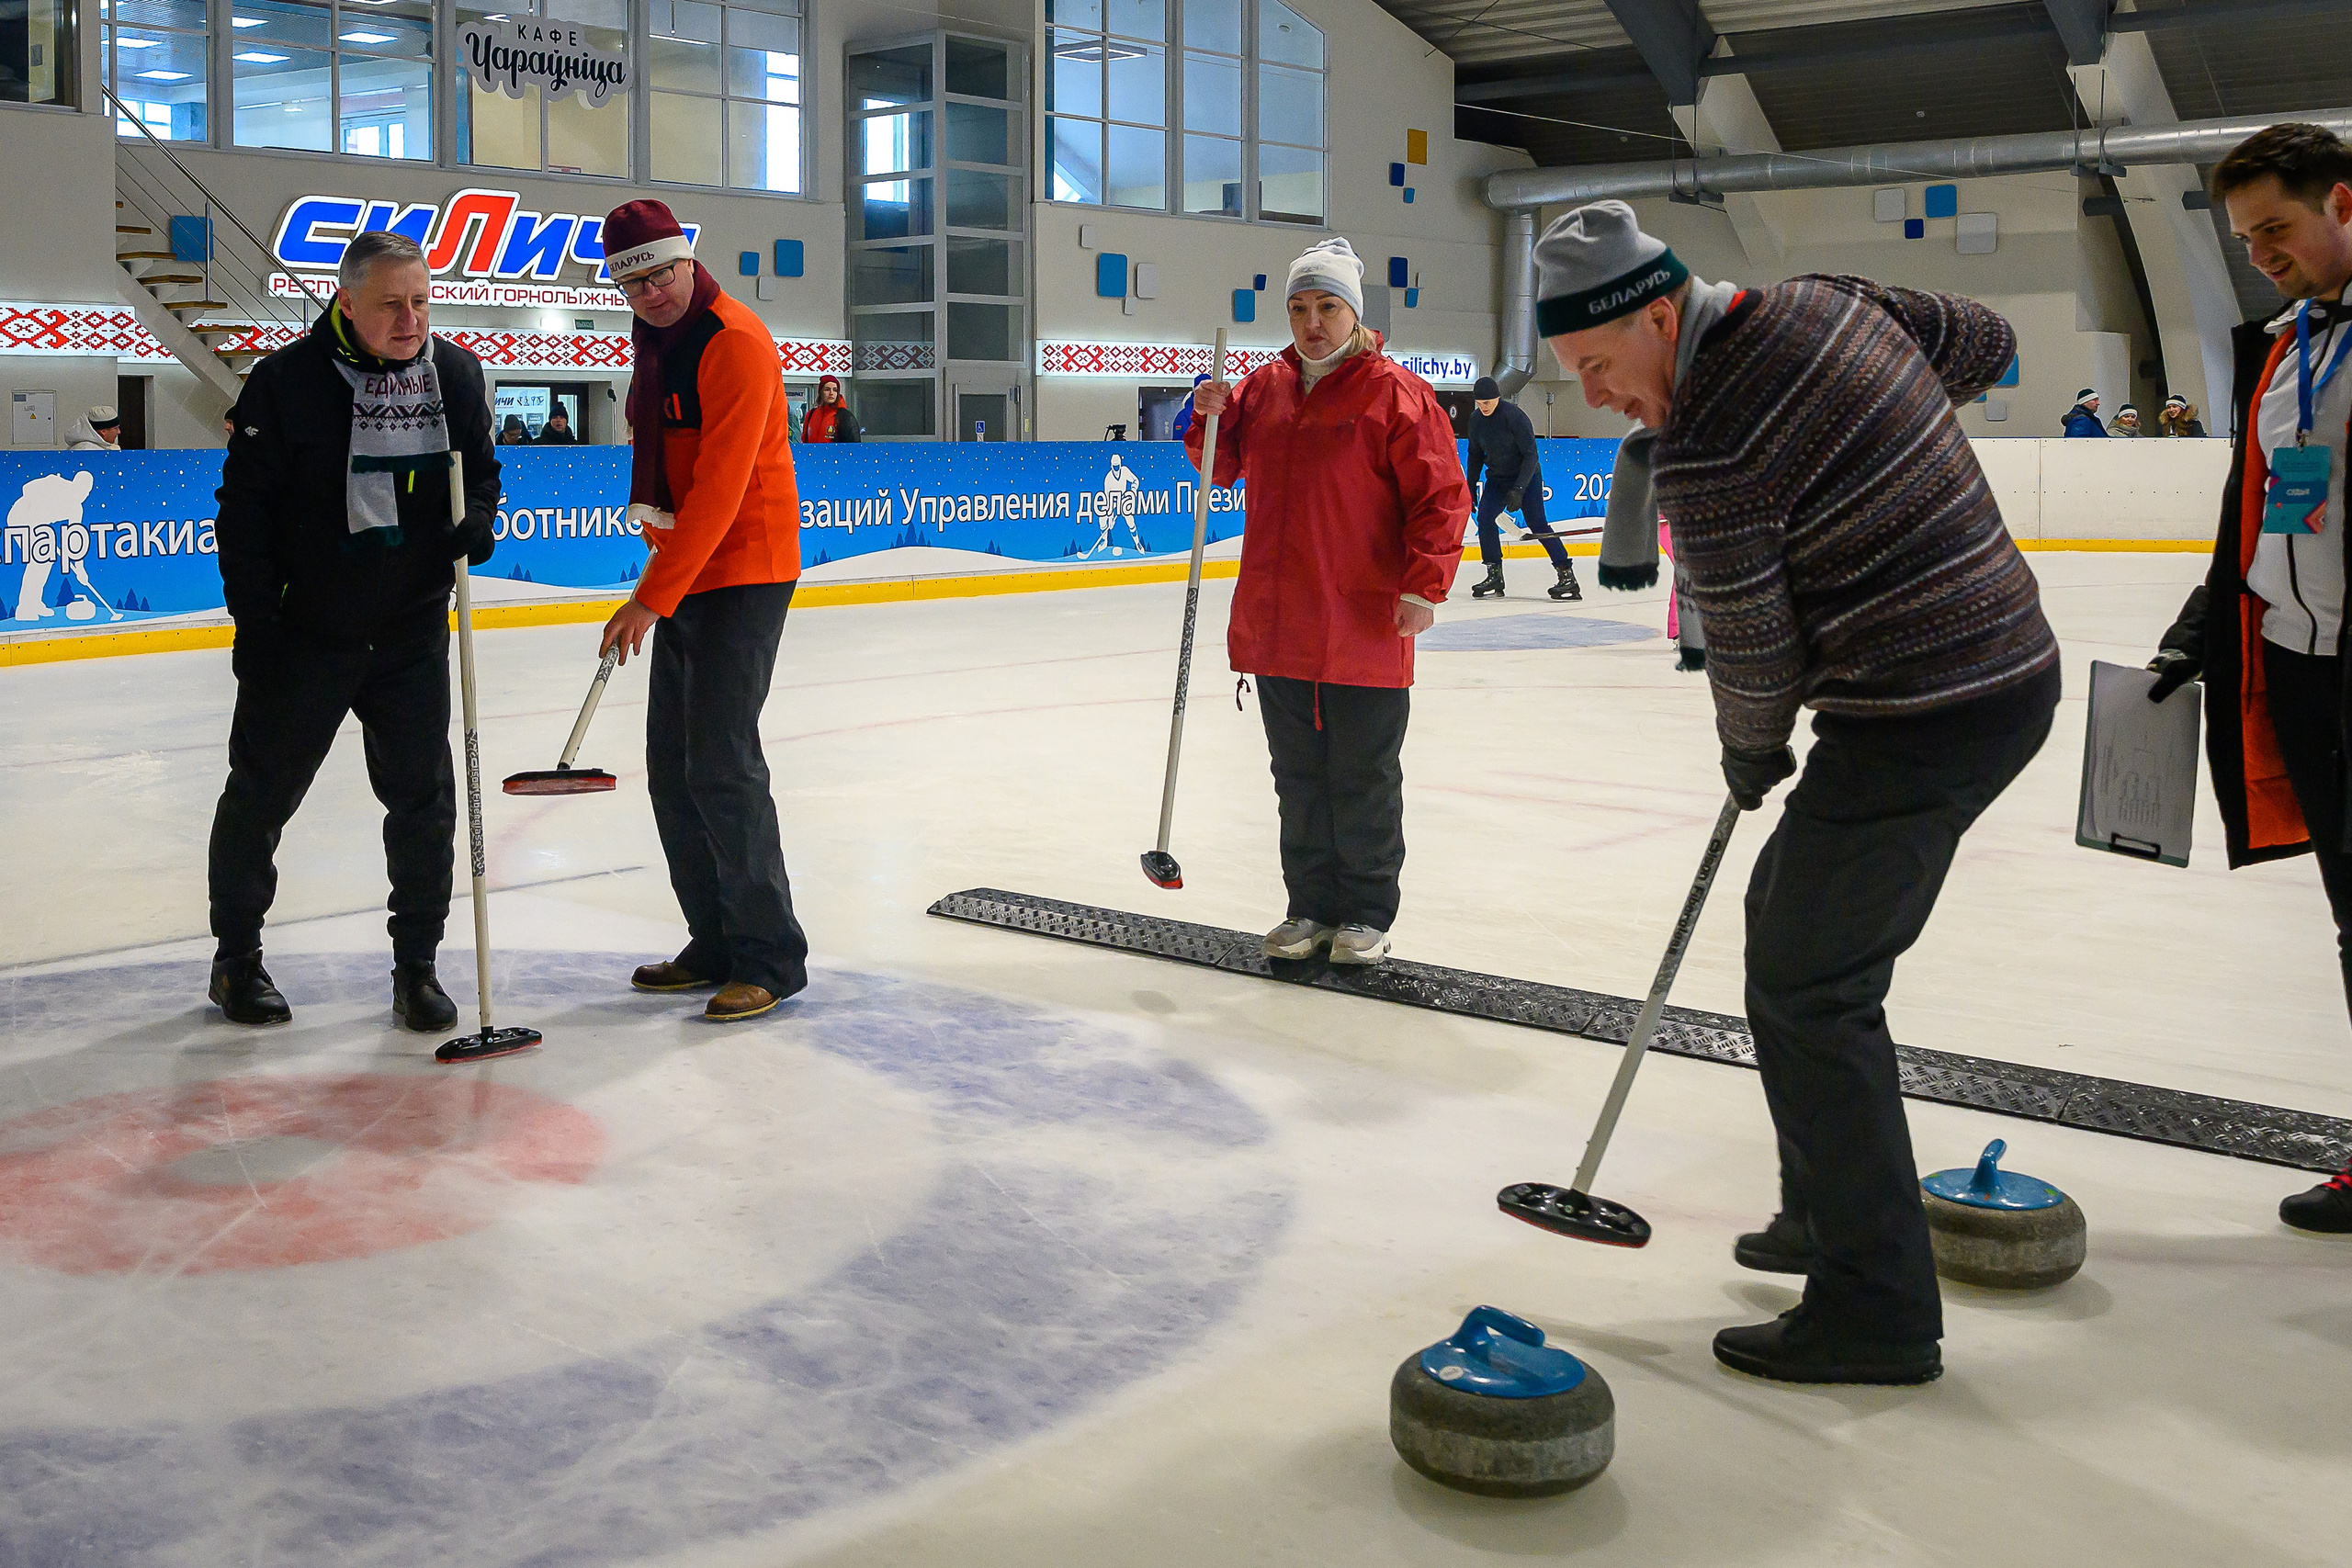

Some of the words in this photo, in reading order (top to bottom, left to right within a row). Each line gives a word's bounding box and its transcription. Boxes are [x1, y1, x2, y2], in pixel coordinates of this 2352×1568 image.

[517, 24, 577, 46] КАФЕ
[465, 31, 627, 98] Чараўніца
[1588, 270, 1670, 316] БЕЛАРУСЬ
[365, 373, 433, 398] ЕДИНЫЕ
[1402, 357, 1472, 379] silichy.by
[899, 488, 1069, 533] Управления
[1076, 490, 1170, 525] делами
